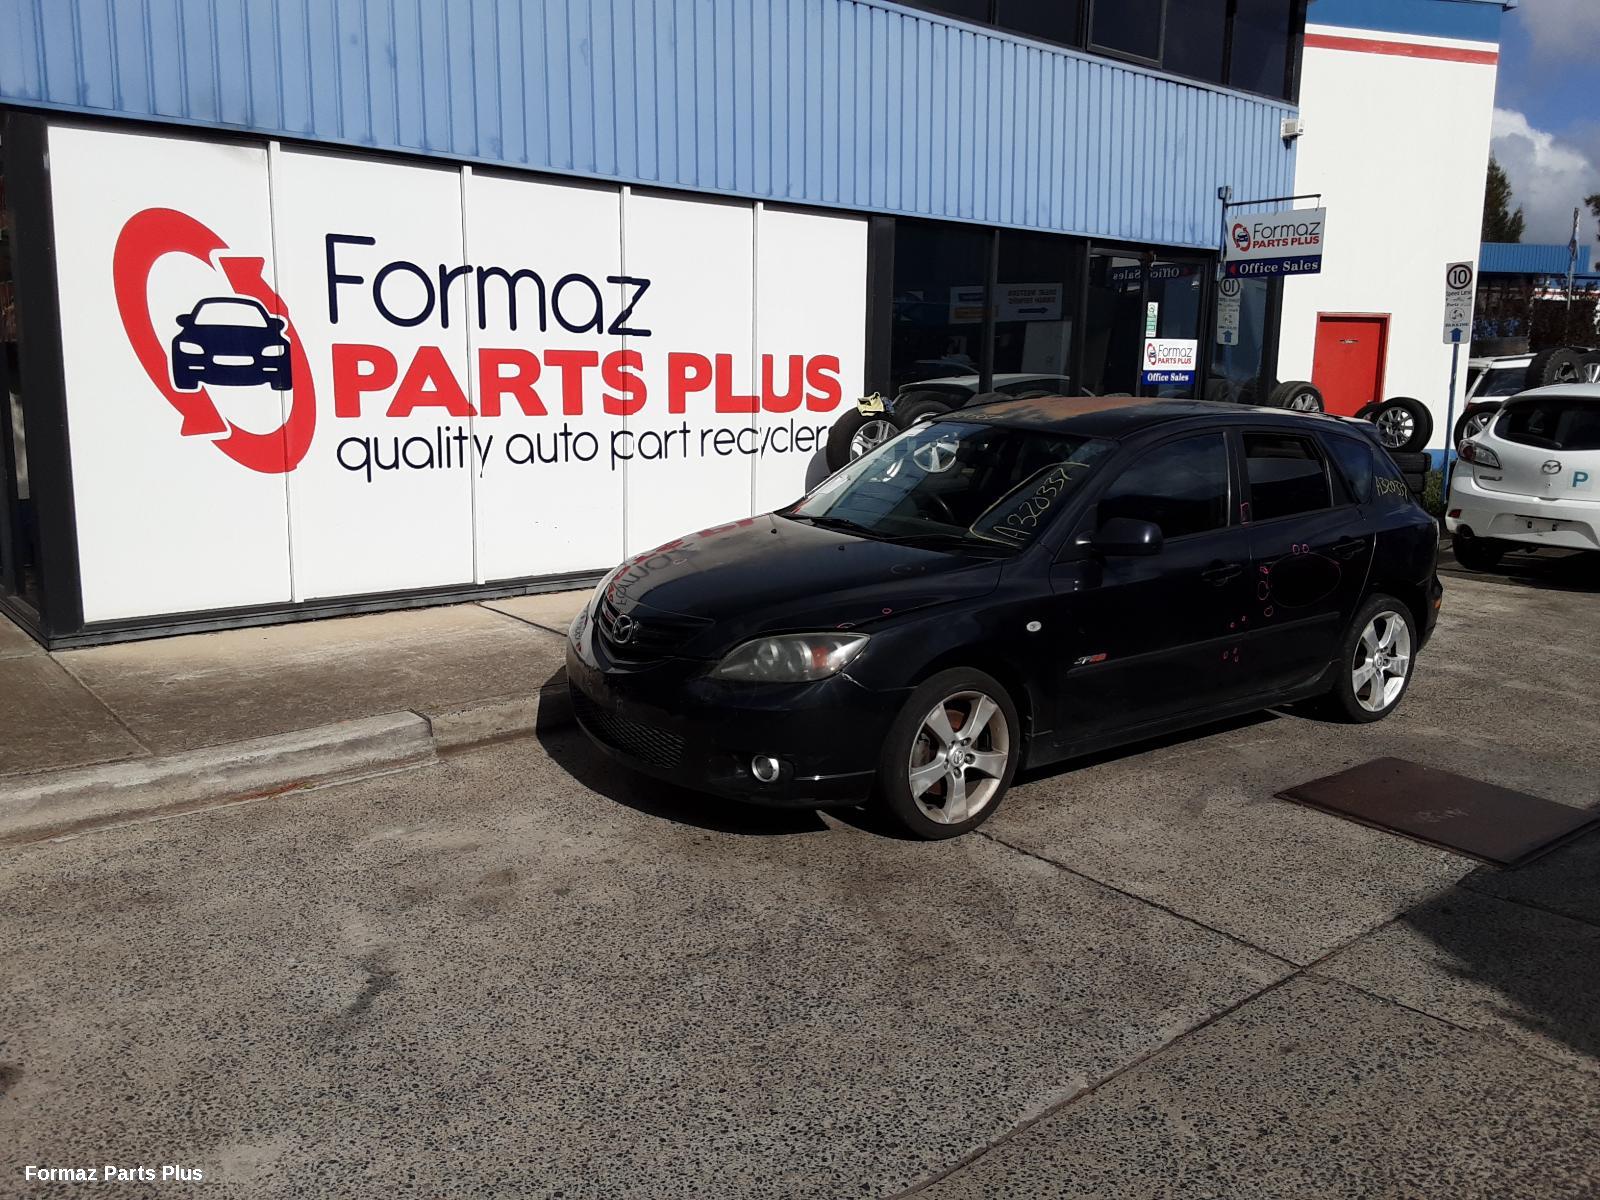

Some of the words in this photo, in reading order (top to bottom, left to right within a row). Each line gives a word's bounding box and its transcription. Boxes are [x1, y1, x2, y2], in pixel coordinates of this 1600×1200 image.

[1253, 222, 1320, 239] Formaz
[1253, 238, 1289, 248] PARTS
[1291, 236, 1320, 246] PLUS
[1240, 263, 1278, 274] Office
[1282, 260, 1318, 272] Sales
[326, 234, 651, 336] Formaz
[1454, 269, 1467, 285] 10
[1158, 344, 1192, 358] Formaz
[332, 344, 647, 417] PARTS
[669, 353, 841, 413] PLUS
[1147, 373, 1169, 382] Office
[1171, 373, 1189, 382] Sales
[337, 426, 493, 482] quality
[506, 423, 598, 464] auto
[611, 422, 690, 470] part
[701, 418, 832, 460] recycler
[1572, 471, 1589, 488] P
